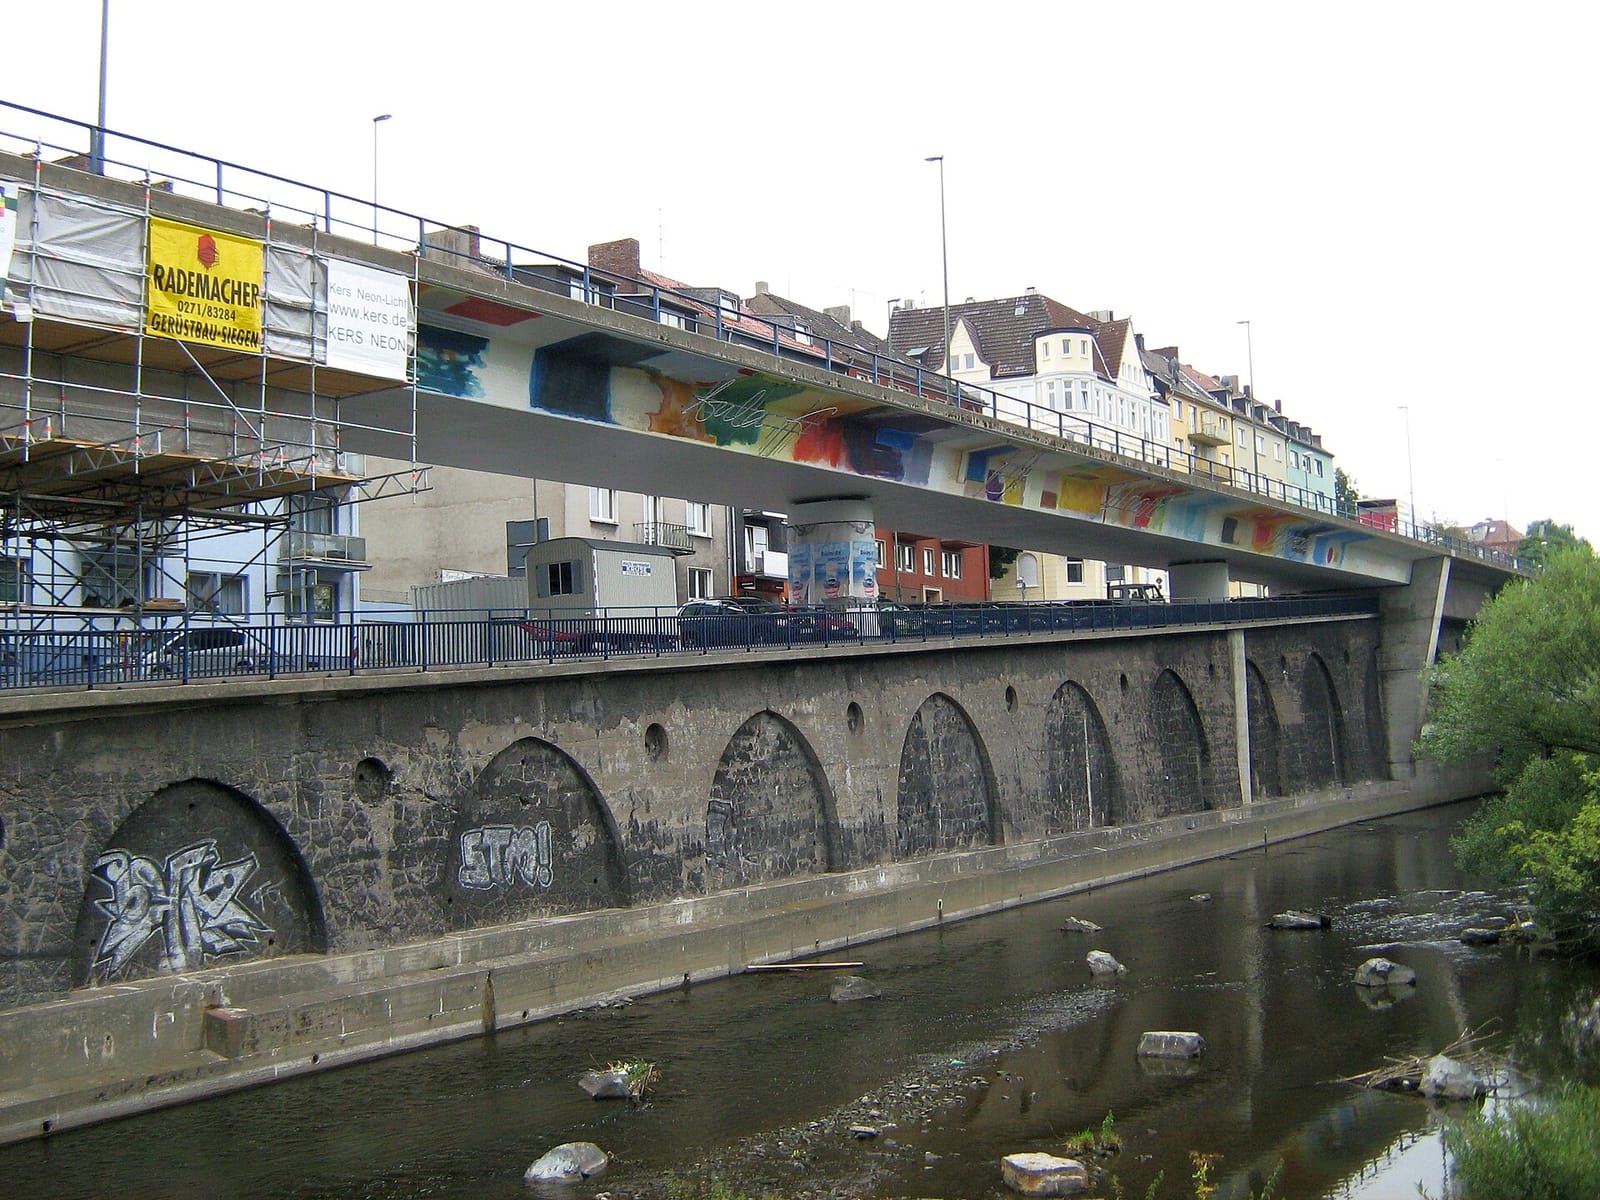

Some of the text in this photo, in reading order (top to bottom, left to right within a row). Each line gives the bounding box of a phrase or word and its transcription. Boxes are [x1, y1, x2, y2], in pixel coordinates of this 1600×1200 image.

[153, 264, 259, 309] RADEMACHER
[329, 282, 352, 297] Kers
[177, 300, 236, 321] 0271/83284
[329, 303, 407, 327] www.kers.de
[328, 326, 406, 352] KERS NEON
